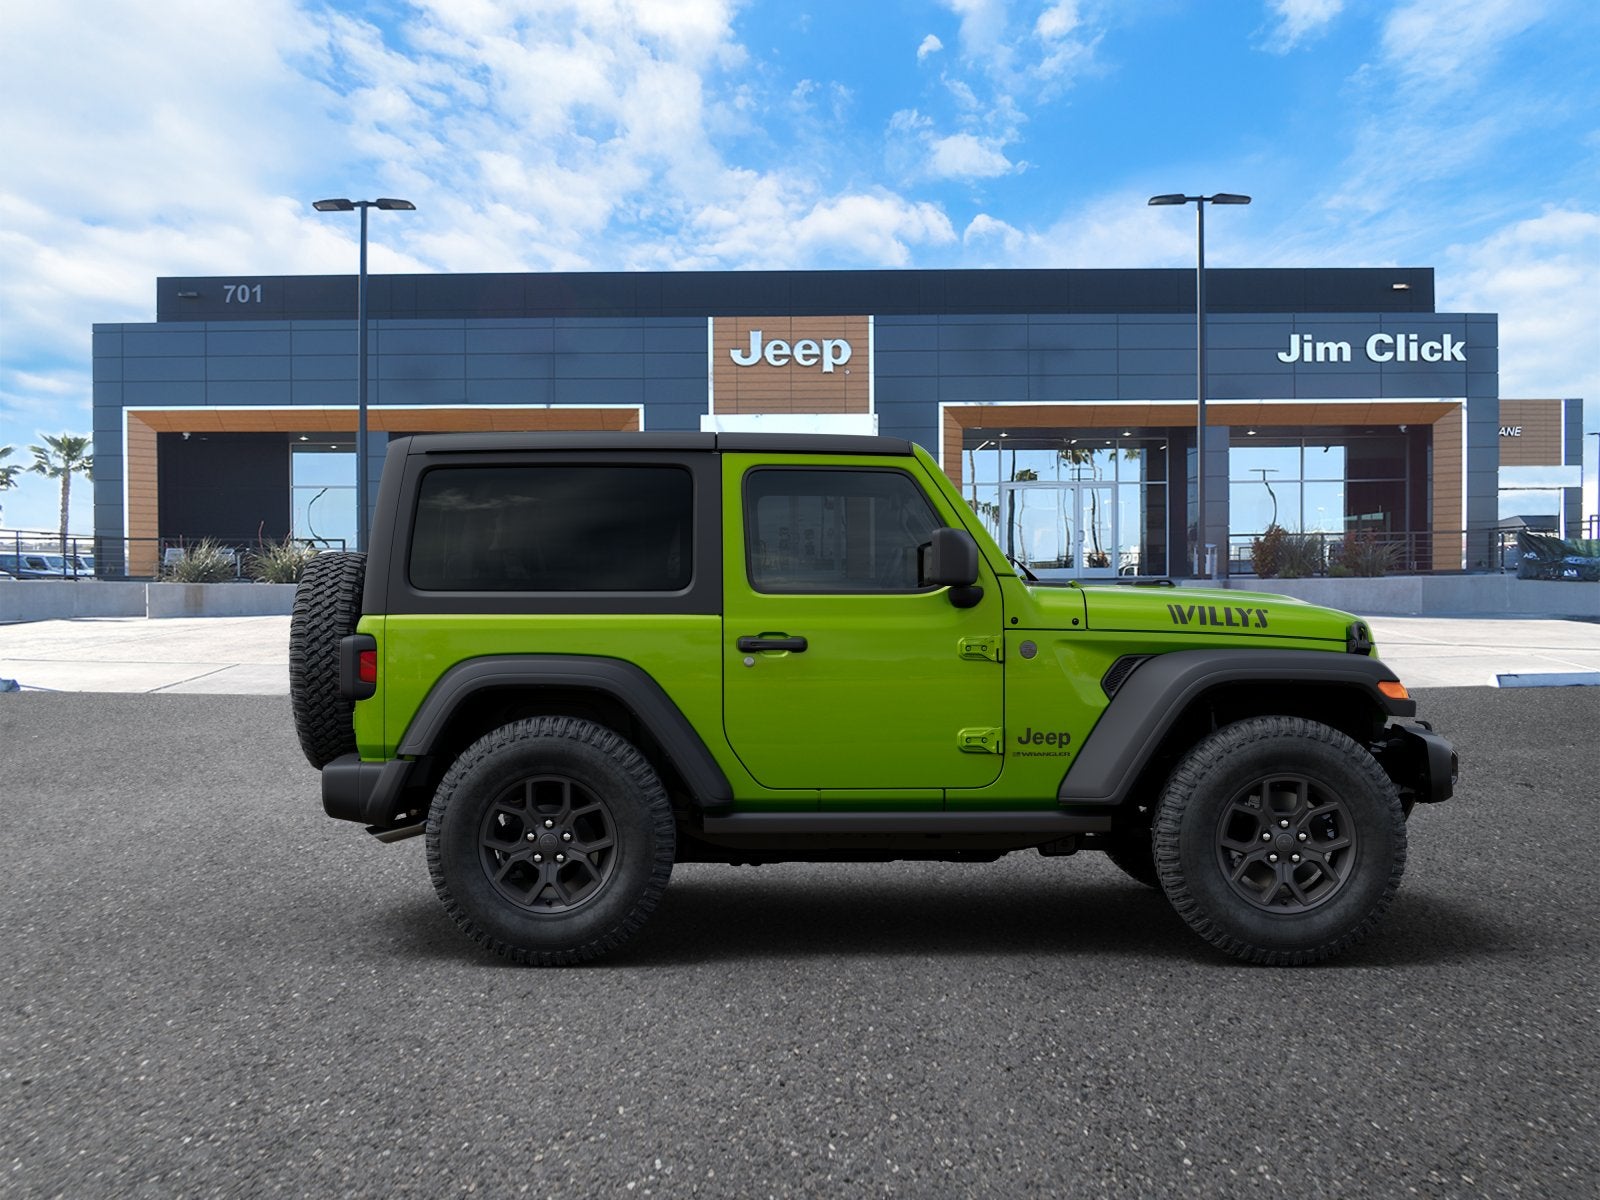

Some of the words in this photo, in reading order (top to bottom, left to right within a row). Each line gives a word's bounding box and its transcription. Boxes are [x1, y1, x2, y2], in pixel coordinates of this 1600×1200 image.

[223, 284, 262, 304] 701
[729, 330, 852, 373] Jeep
[1277, 333, 1351, 362] Jim
[1365, 333, 1467, 362] Click
[1167, 604, 1269, 629] WILLYS
[1017, 727, 1071, 749] Jeep
